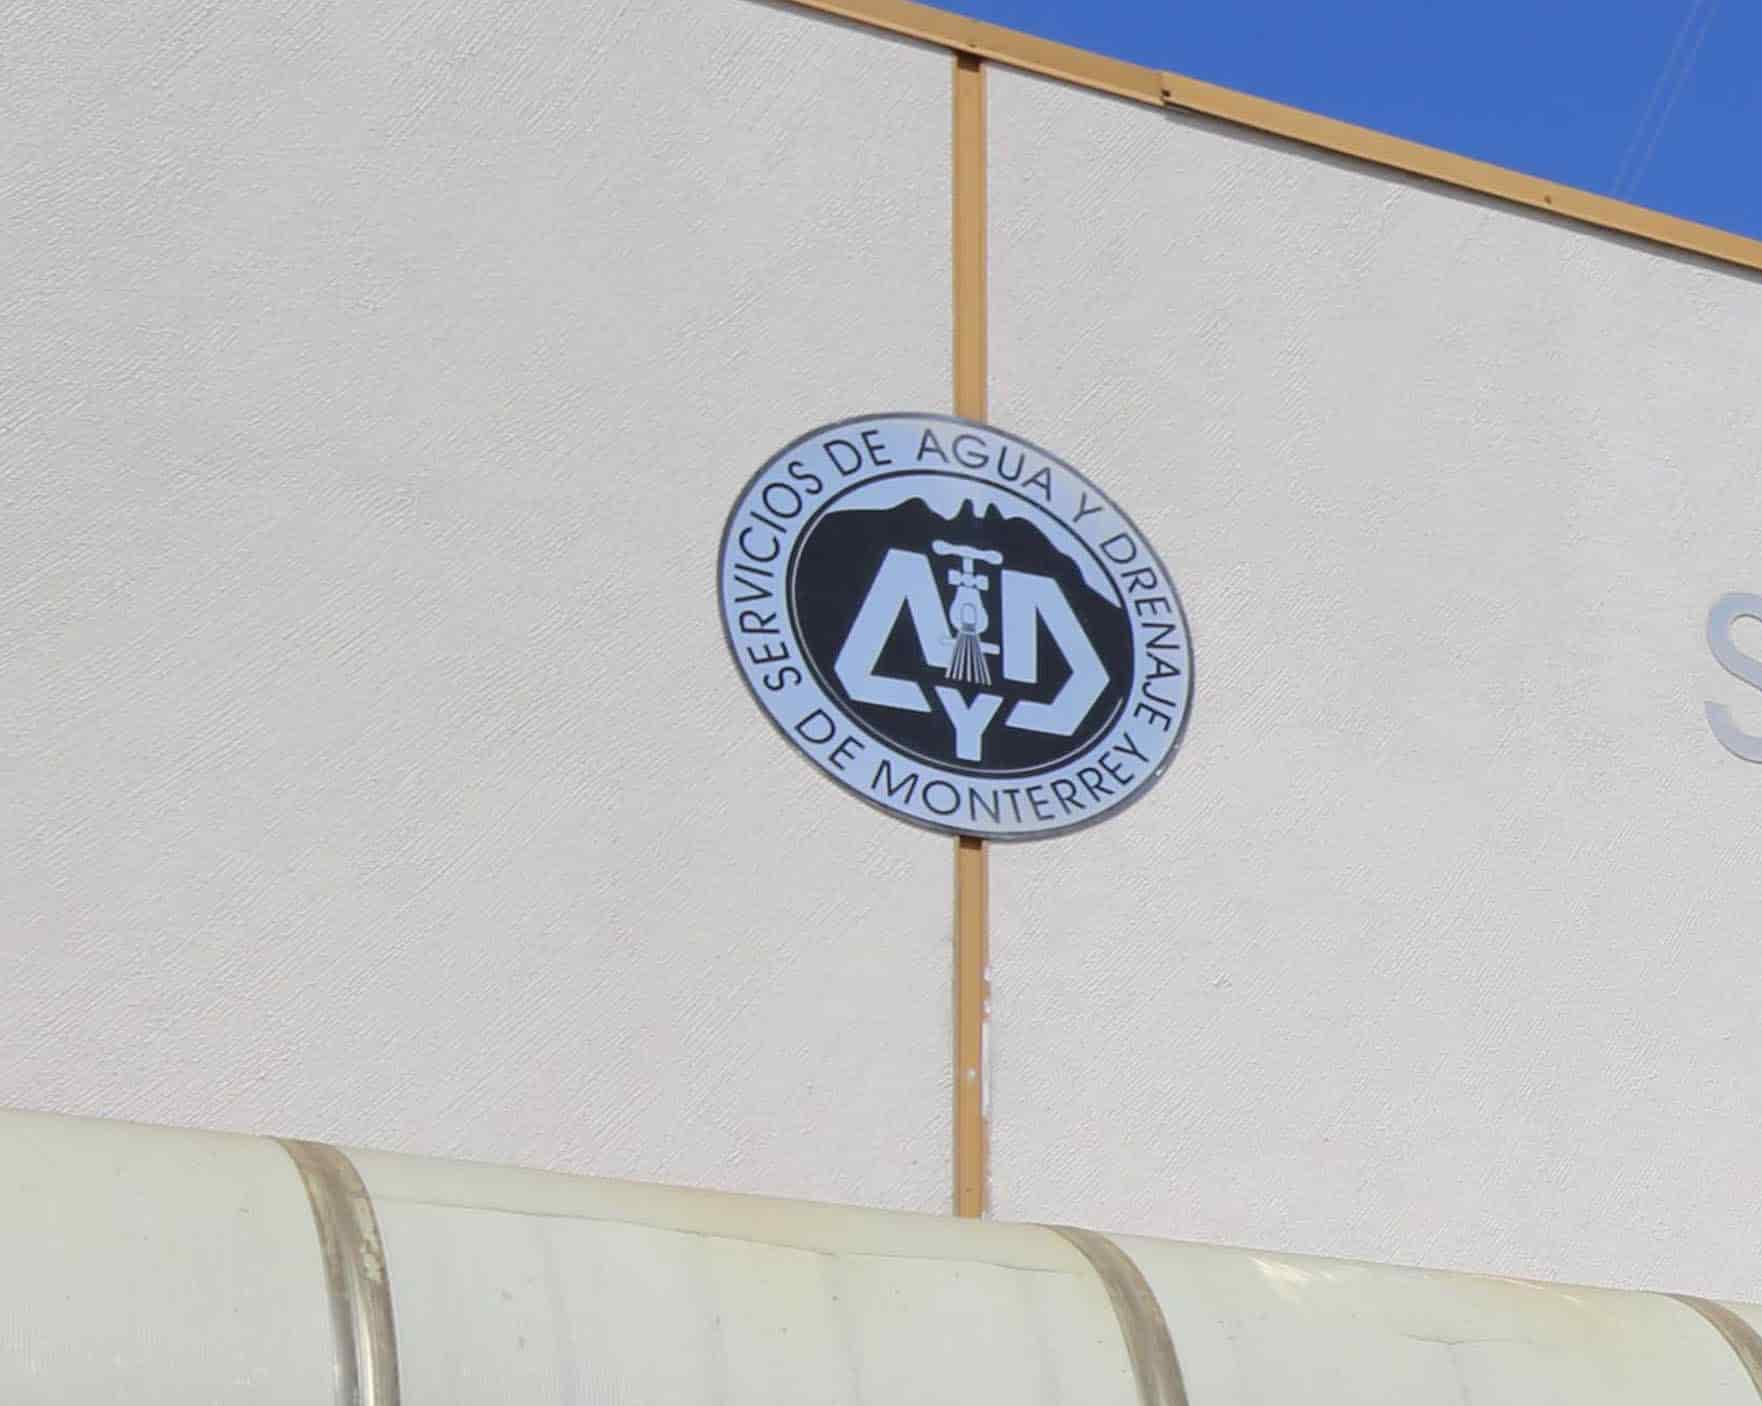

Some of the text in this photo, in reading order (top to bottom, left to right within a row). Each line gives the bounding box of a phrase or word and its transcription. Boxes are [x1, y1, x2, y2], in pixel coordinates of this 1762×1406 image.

[734, 428, 1182, 733] SERVICIOS DE AGUA Y DRENAJE
[794, 708, 1151, 824] DE MONTERREY
